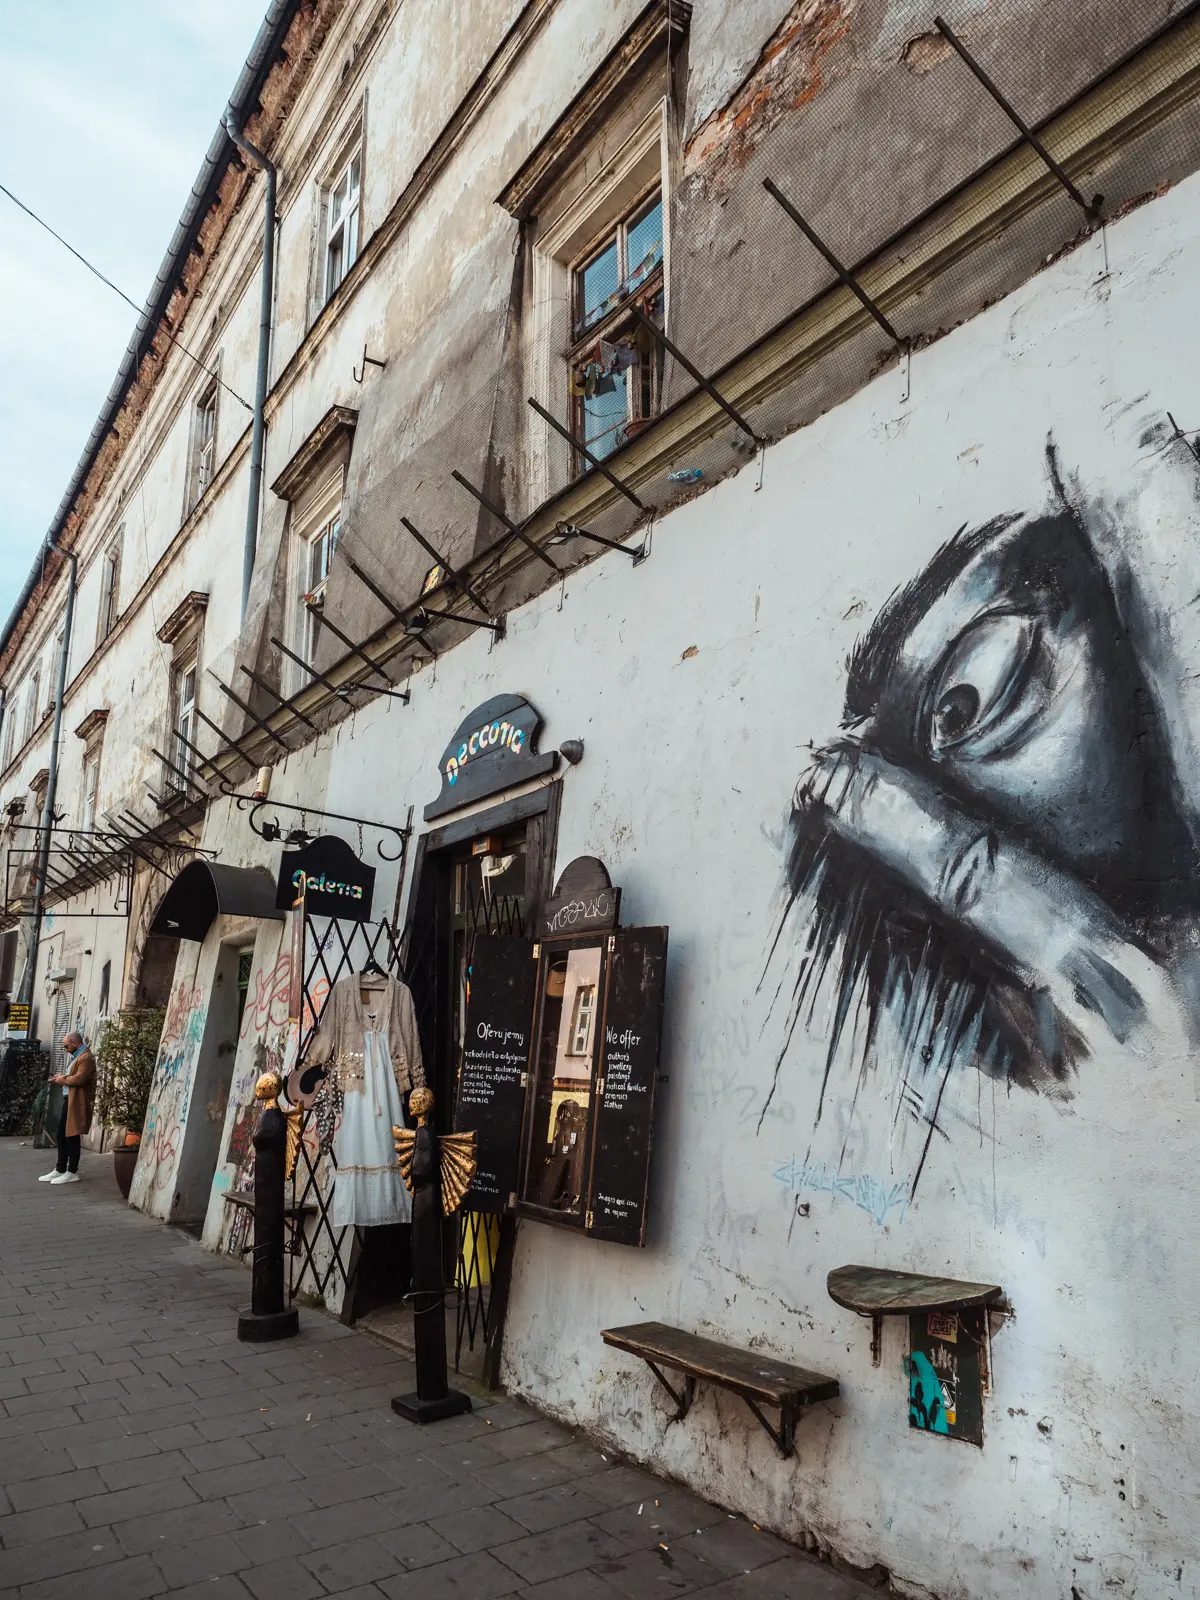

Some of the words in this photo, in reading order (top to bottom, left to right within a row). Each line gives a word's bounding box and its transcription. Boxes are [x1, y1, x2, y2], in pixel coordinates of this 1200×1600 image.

[476, 1022, 524, 1047] Oferujemy
[606, 1025, 618, 1044] We
[619, 1029, 641, 1050] offer
[462, 1096, 490, 1105] ubrania
